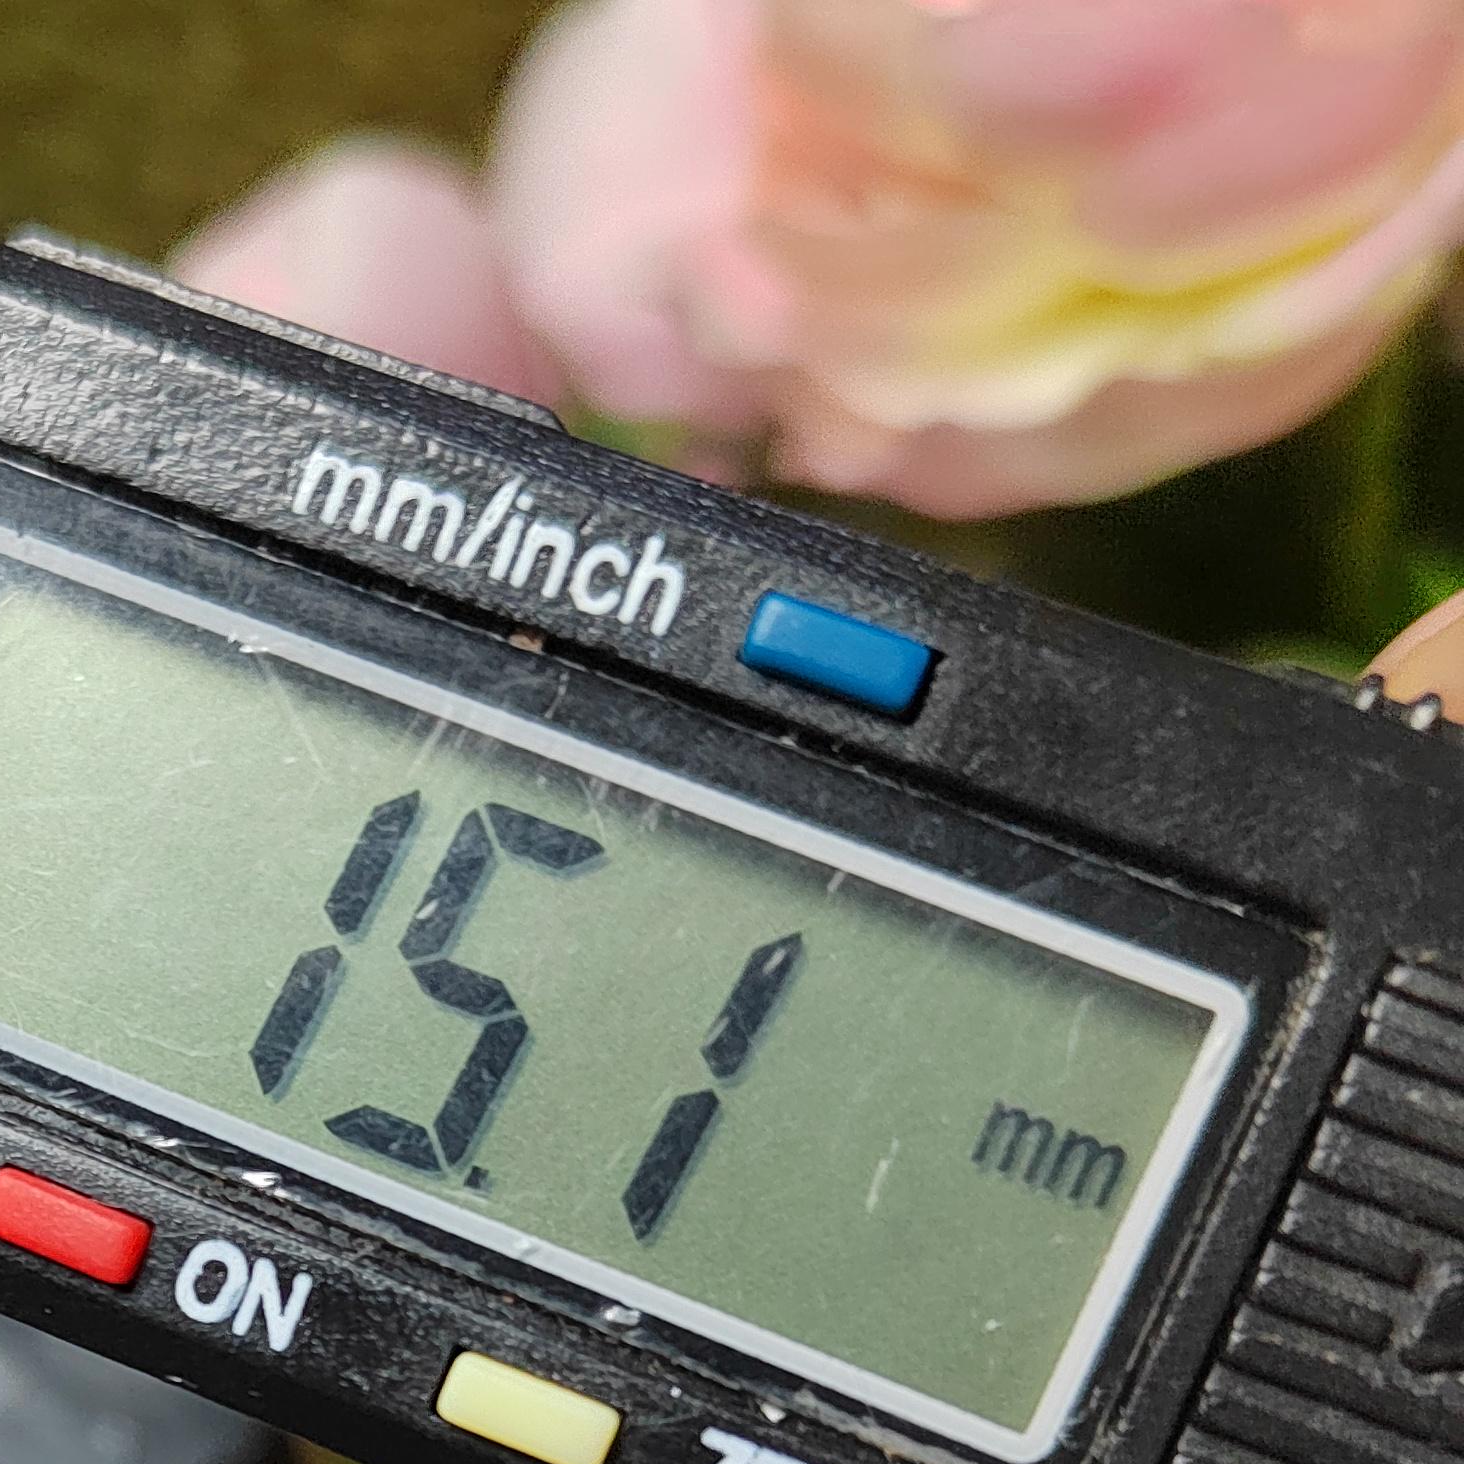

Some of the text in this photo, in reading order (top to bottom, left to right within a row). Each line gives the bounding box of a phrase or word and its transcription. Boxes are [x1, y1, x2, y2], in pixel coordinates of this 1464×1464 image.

[292, 446, 686, 637] mm/inch
[249, 788, 1128, 1246] 15.1 mm
[174, 1238, 315, 1353] ON
